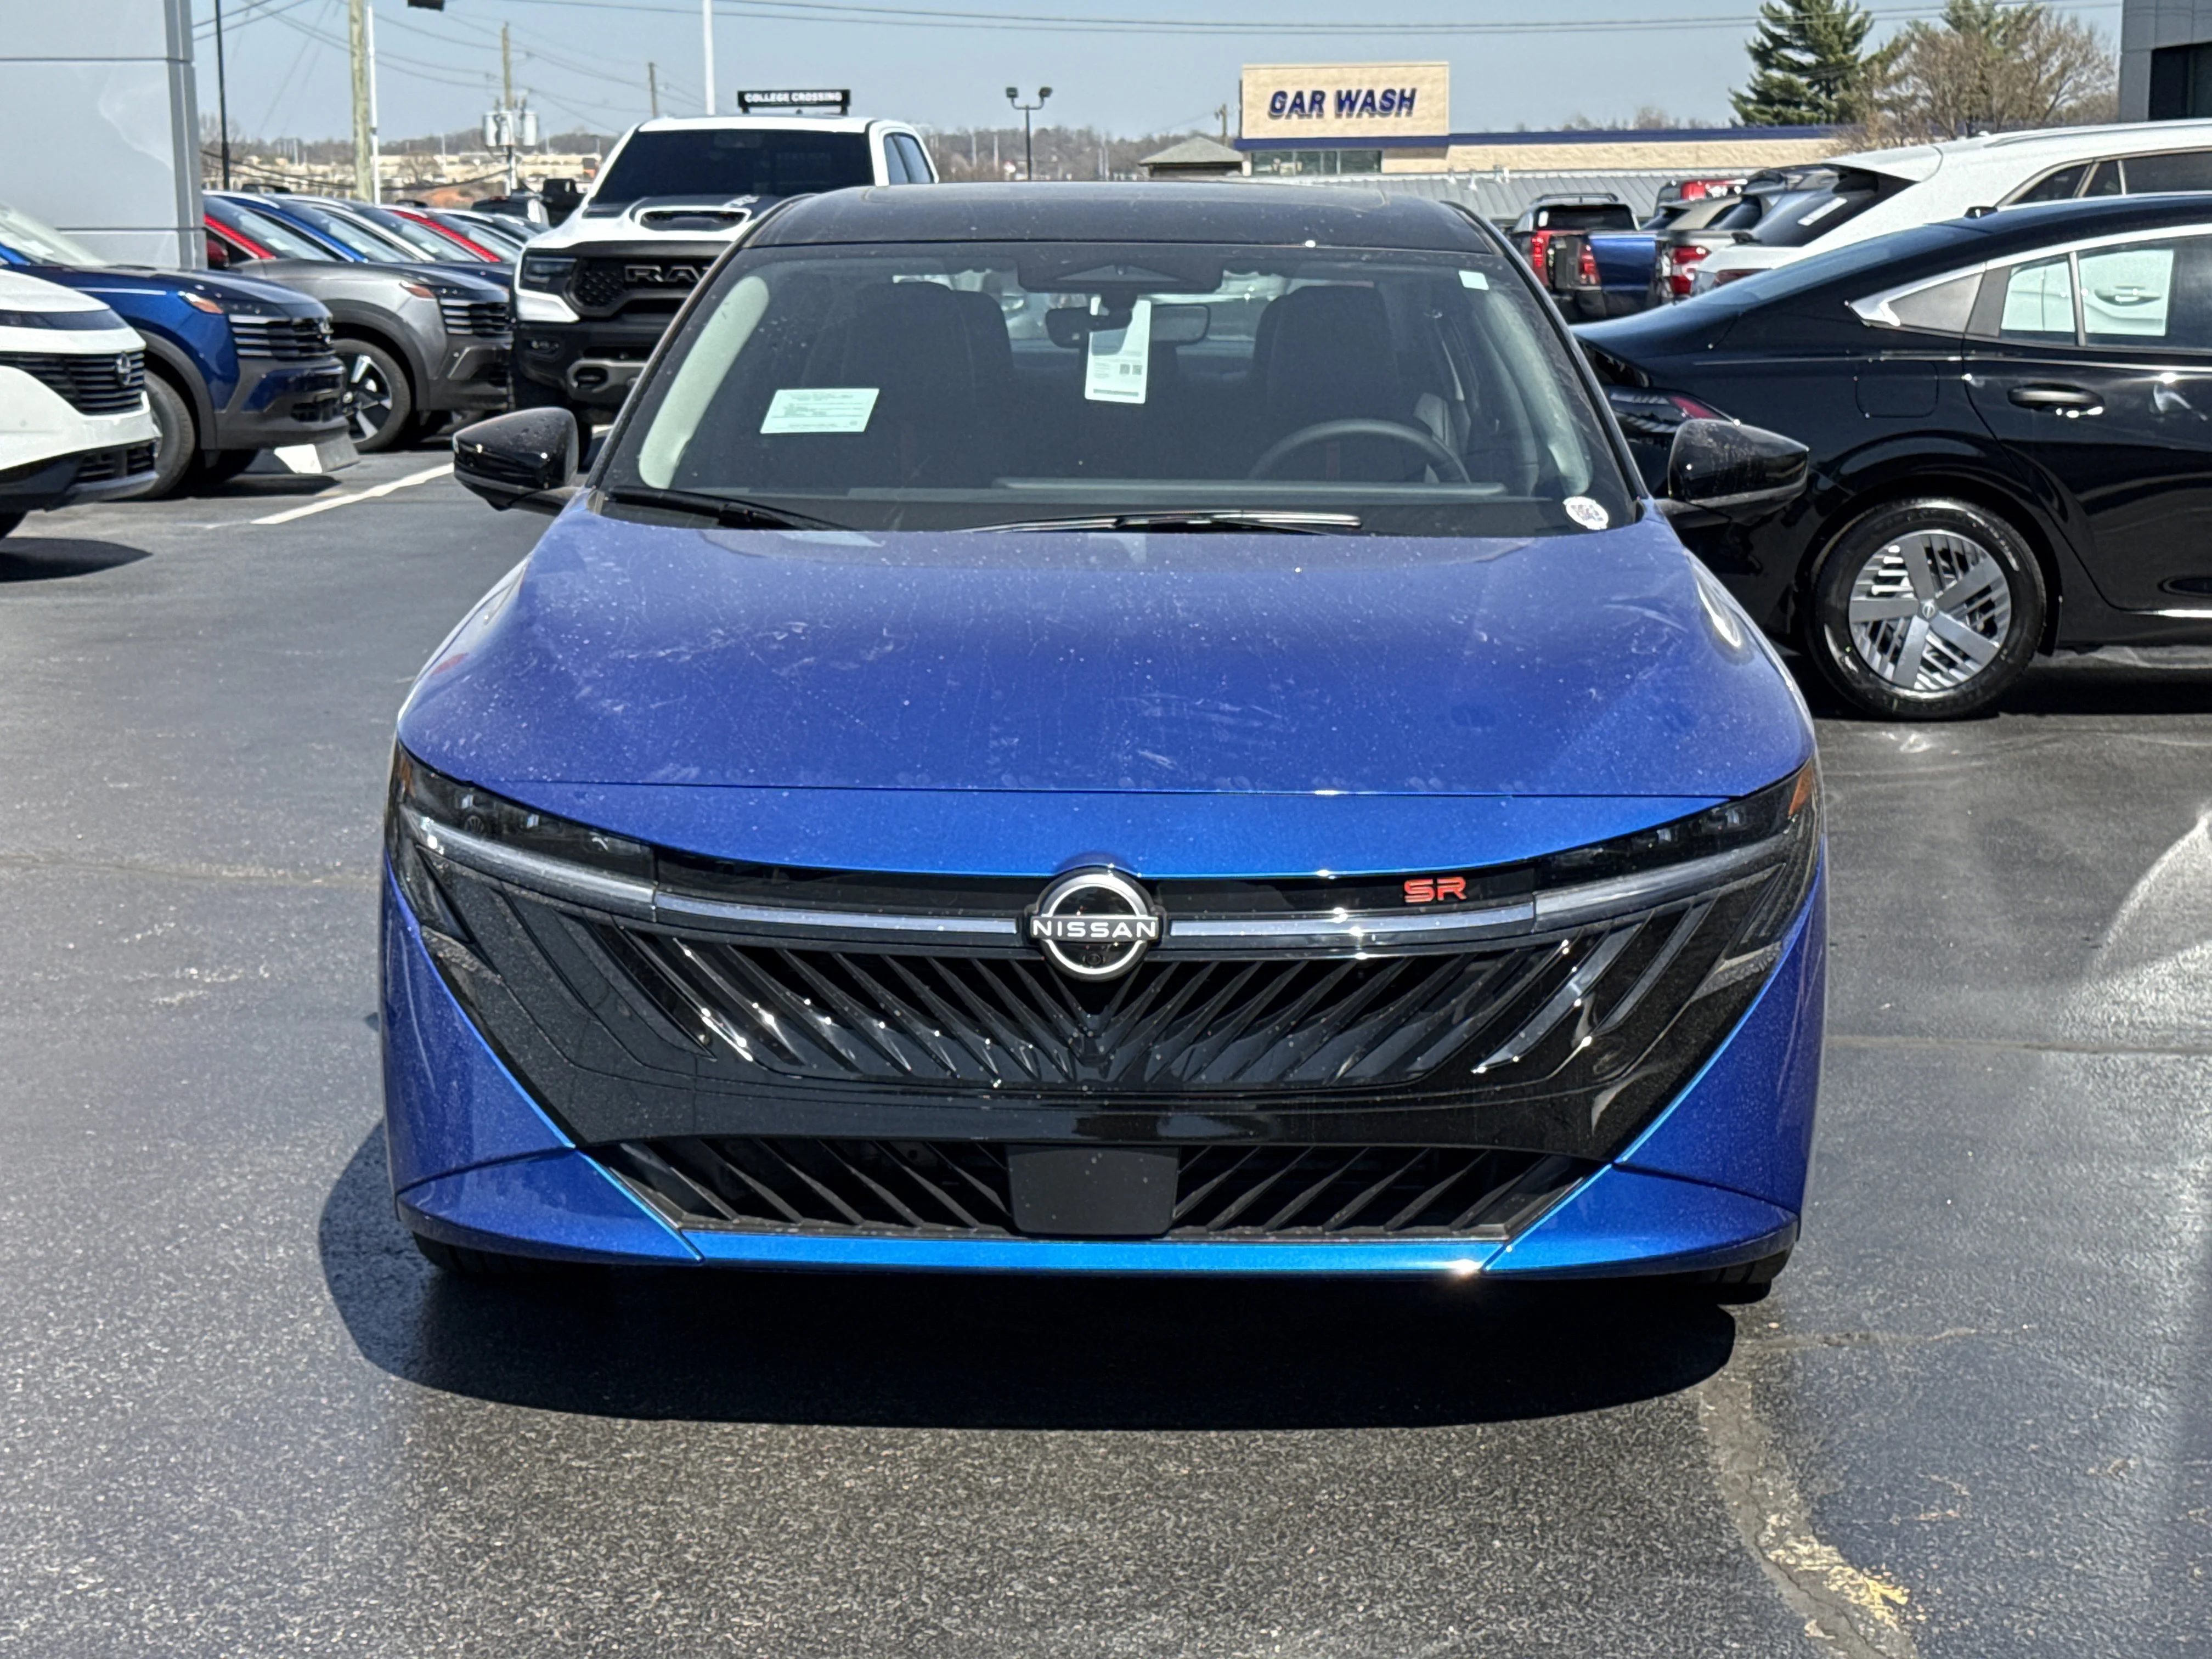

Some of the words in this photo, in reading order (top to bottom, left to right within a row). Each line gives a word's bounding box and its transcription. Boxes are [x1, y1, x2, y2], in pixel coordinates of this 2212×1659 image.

[744, 92, 791, 103] COLLEGE
[791, 91, 843, 102] CROSSING
[1335, 88, 1417, 115] WASH
[624, 264, 711, 283] RA
[1404, 876, 1467, 903] SR
[1032, 919, 1156, 938] NISSAN
